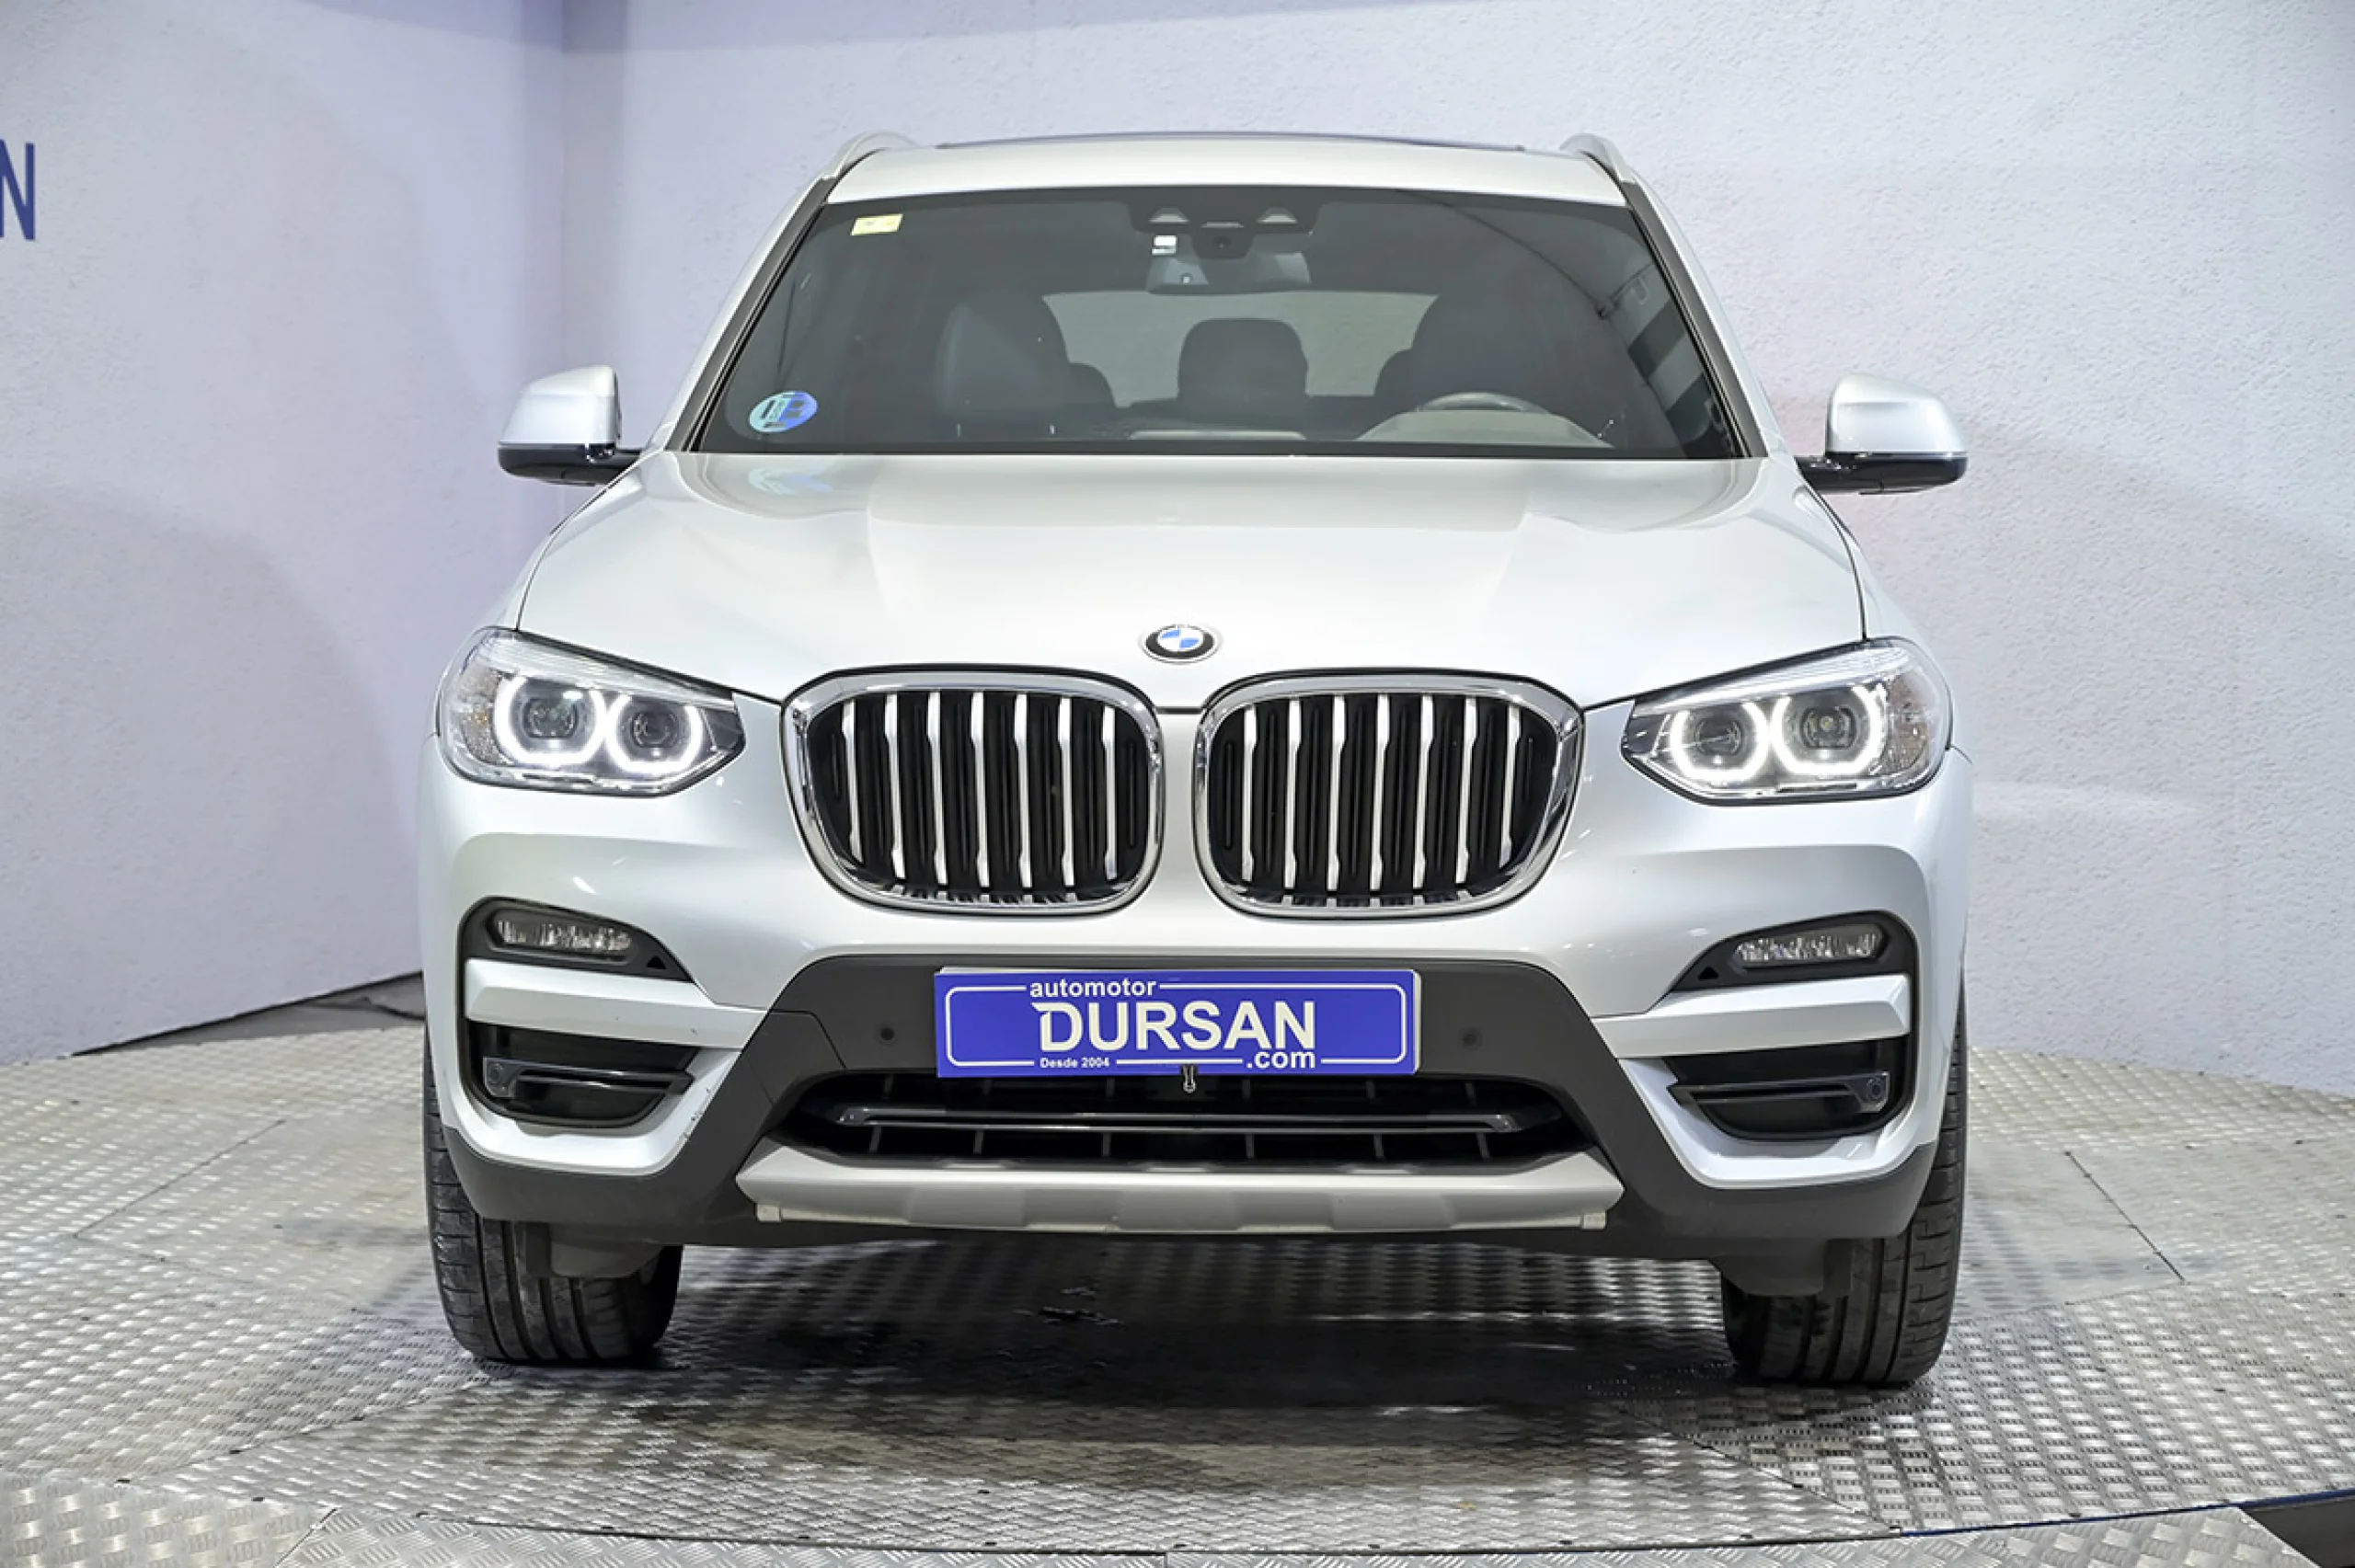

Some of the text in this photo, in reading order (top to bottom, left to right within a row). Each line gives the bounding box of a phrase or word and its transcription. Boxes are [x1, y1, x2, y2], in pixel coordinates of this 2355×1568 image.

[1029, 979, 1155, 997] automotor
[1031, 1001, 1315, 1051] DURSAN
[1040, 1057, 1109, 1068] Desde 2004
[1246, 1049, 1316, 1070] .com
